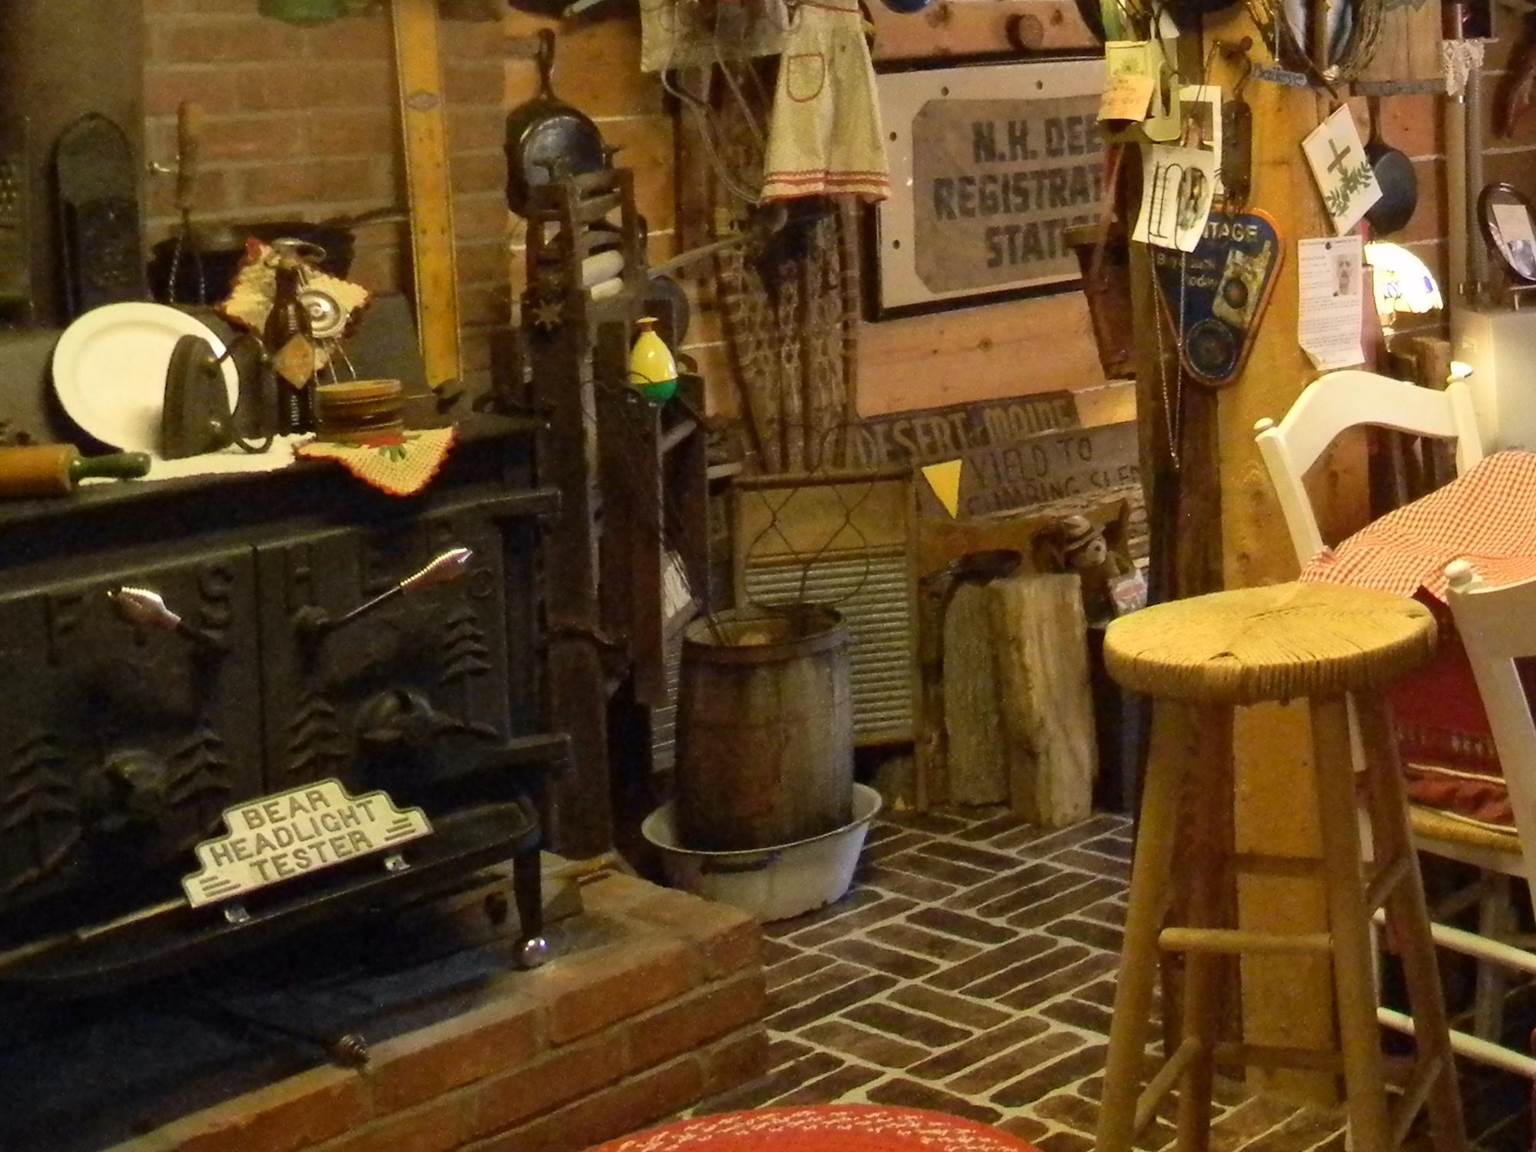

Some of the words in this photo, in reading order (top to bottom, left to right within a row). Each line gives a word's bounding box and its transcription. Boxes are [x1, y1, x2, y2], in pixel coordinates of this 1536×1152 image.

[972, 120, 1039, 165] N.H.
[1044, 112, 1103, 159] DEE
[932, 162, 1105, 222] REGISTRAT
[984, 213, 1101, 269] STATI
[1056, 436, 1093, 465] TO
[210, 799, 378, 868] HEADLIGHT
[241, 789, 331, 831] BEAR
[249, 829, 374, 883] TESTER
